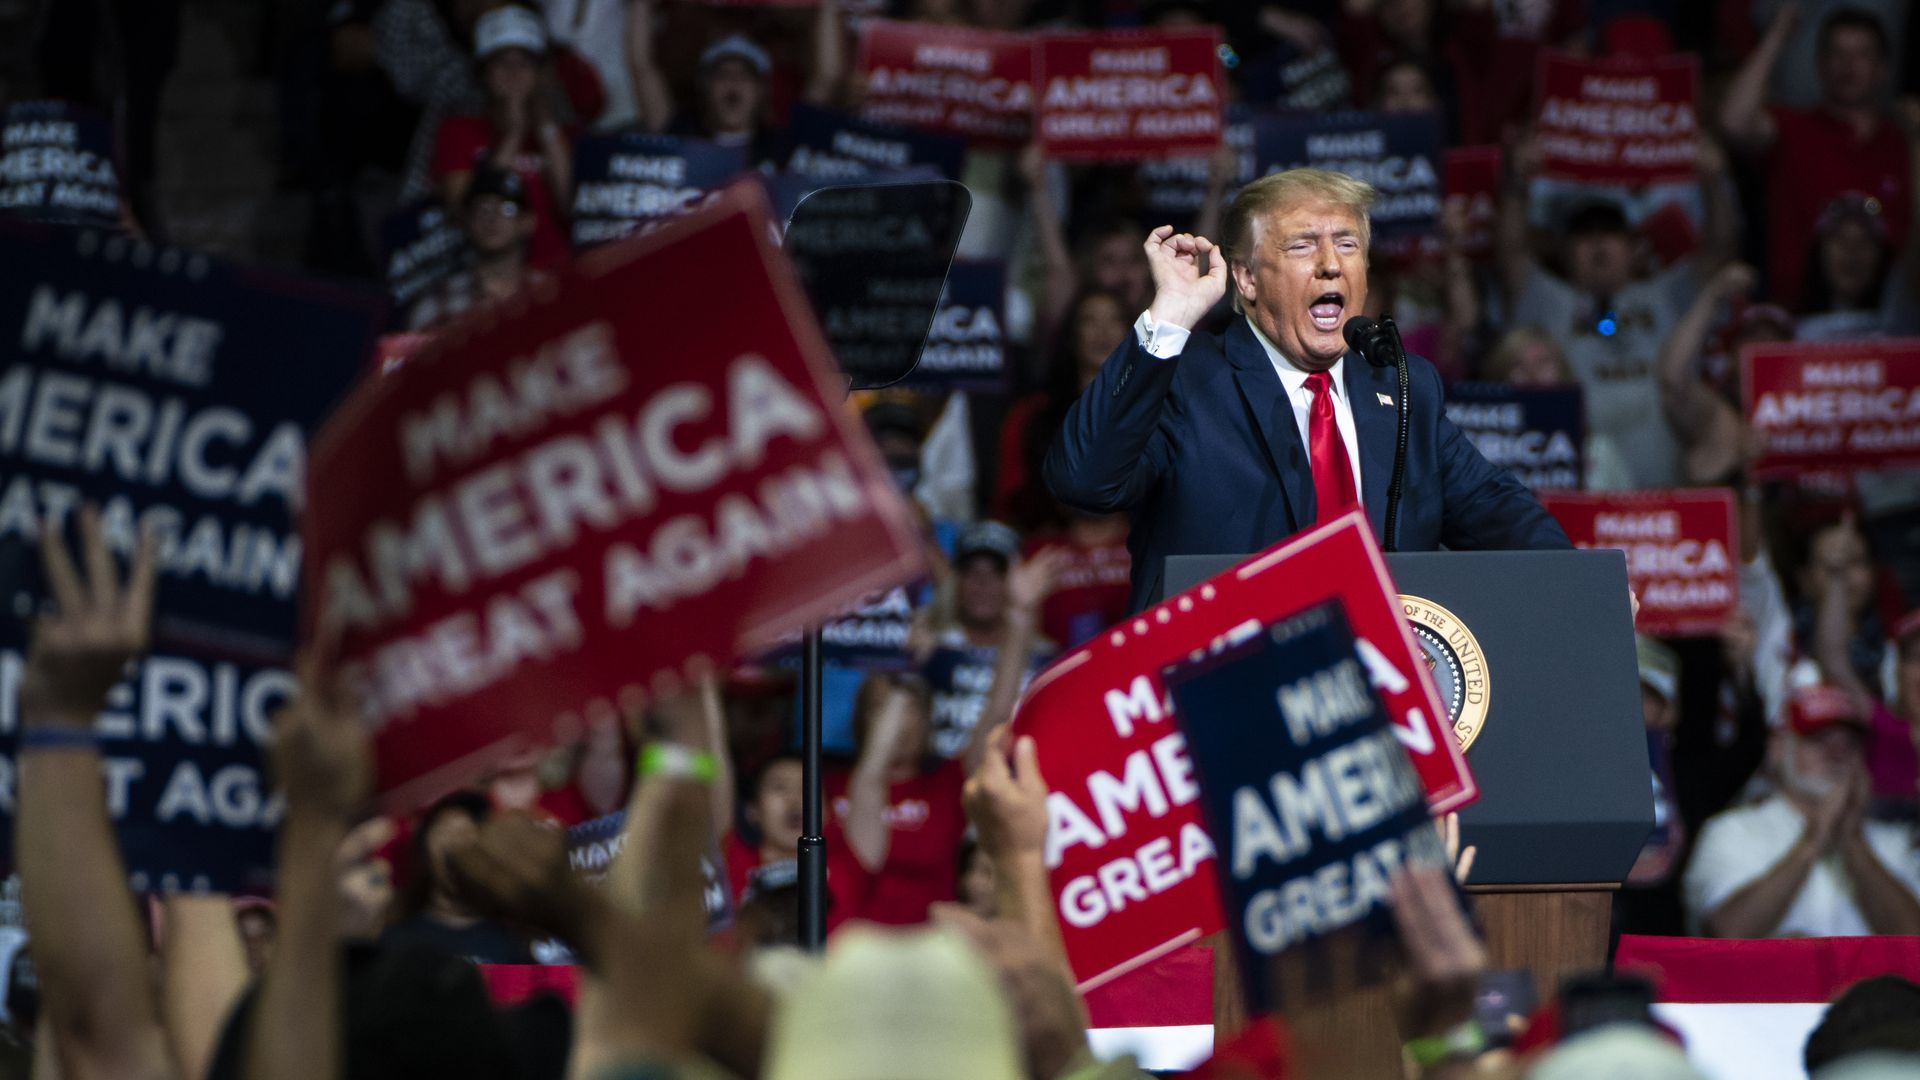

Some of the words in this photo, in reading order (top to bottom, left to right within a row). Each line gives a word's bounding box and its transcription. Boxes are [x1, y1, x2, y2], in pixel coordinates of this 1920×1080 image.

[1089, 47, 1169, 75] MAKE
[867, 66, 1032, 110] AMERICA
[1045, 72, 1217, 109] AMERICA
[1580, 75, 1660, 102] MAKE
[1541, 97, 1697, 137] AMERICA
[20, 282, 224, 388] MAKE
[1801, 359, 1884, 388] MAKE
[398, 318, 632, 488] MAKE
[316, 350, 825, 635] AMERICA
[600, 448, 872, 632] AGAIN
[1593, 510, 1680, 540] MAKE
[1641, 578, 1733, 608] AGAIN
[1403, 604, 1421, 617] OF
[1424, 610, 1446, 630] THE
[1449, 628, 1483, 705] UNITED
[1058, 822, 1218, 929] GREA
